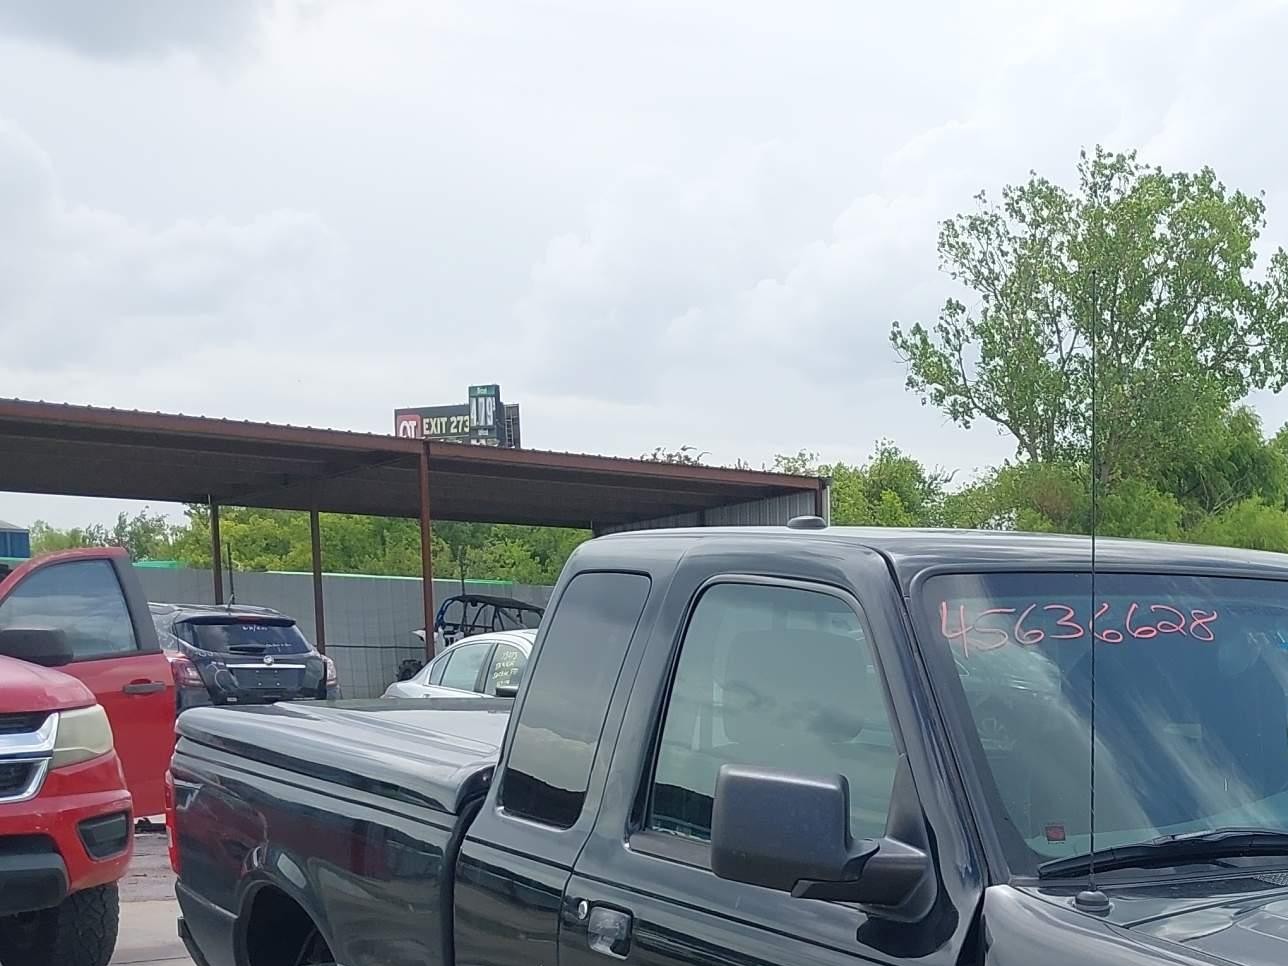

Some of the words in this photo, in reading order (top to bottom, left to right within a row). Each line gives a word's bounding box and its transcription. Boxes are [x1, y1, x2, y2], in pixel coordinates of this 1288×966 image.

[423, 417, 448, 434] EXIT
[450, 415, 470, 433] 273
[940, 600, 1218, 658] 45636628
